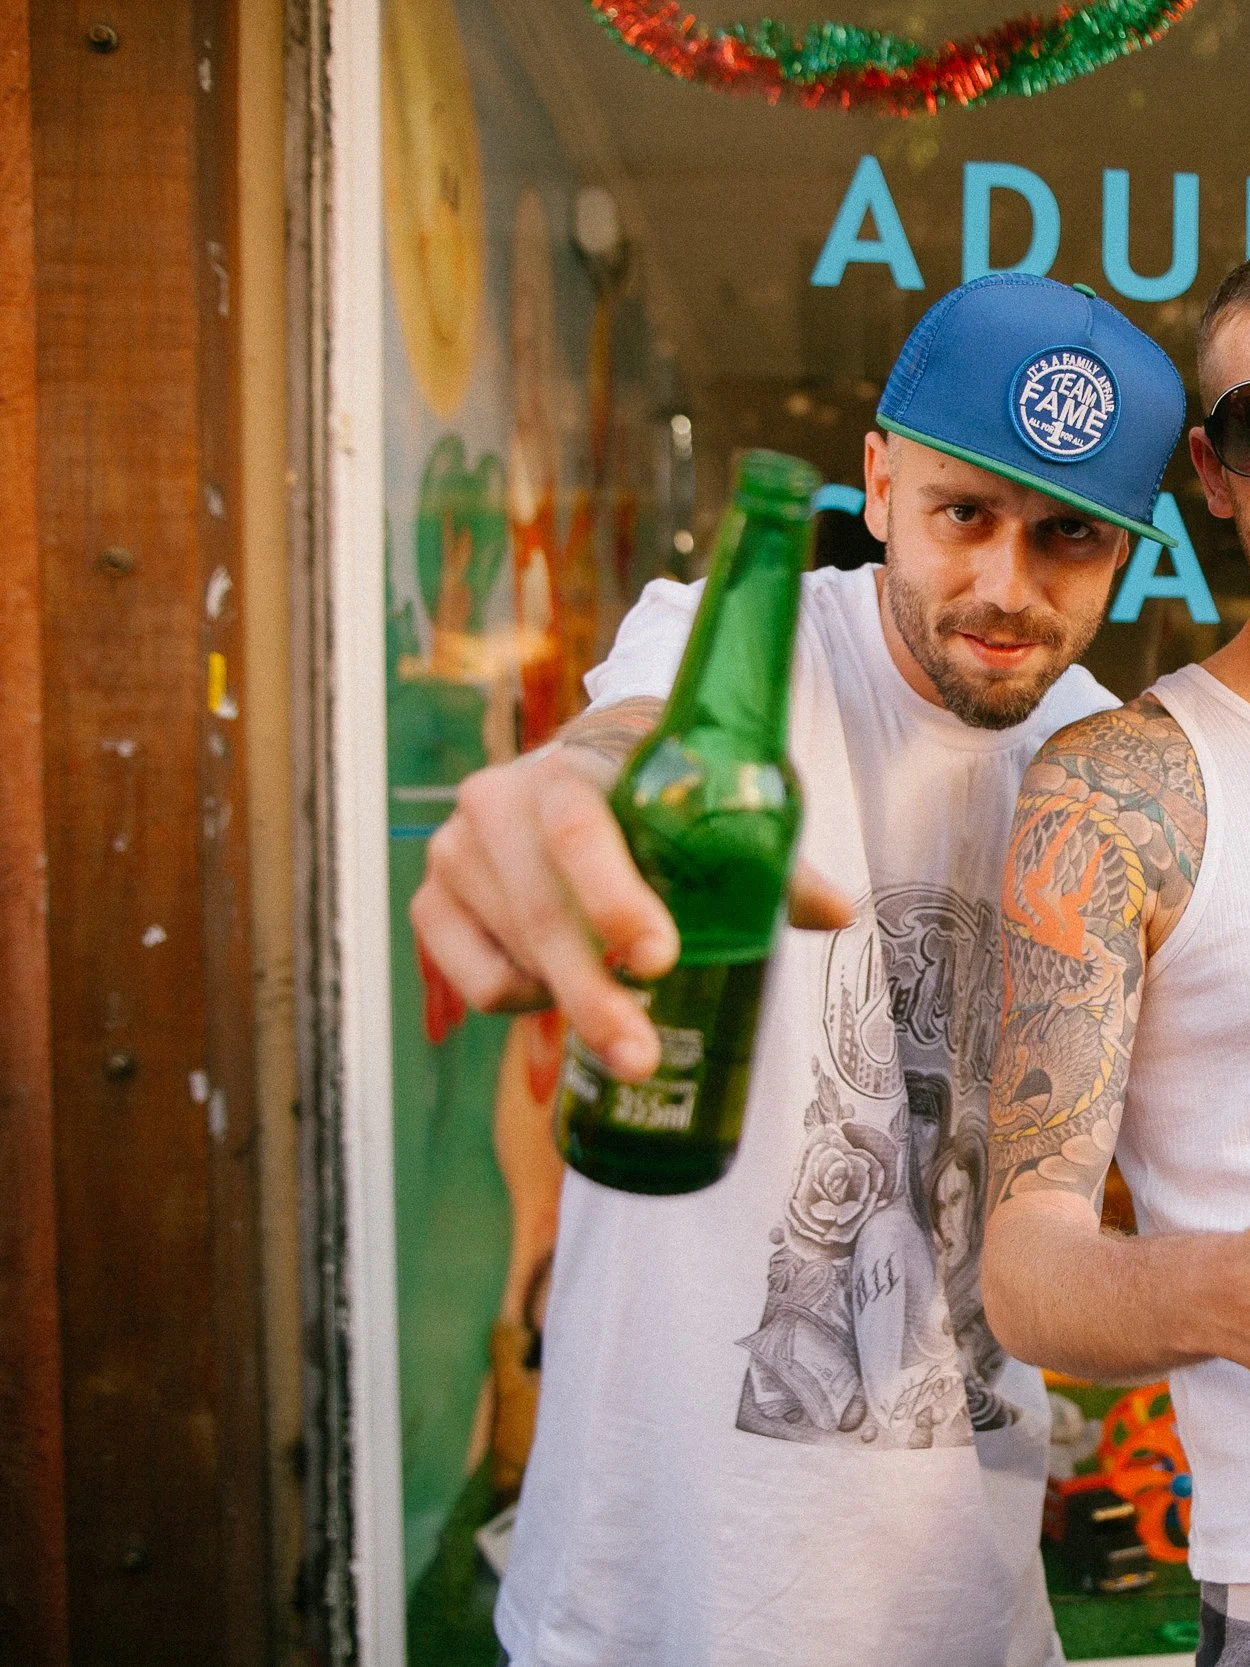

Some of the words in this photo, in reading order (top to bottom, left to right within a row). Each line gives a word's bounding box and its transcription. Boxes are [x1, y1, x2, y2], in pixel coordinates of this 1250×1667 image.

[1027, 359, 1049, 379] IT'S
[1052, 355, 1060, 366] A
[1063, 353, 1100, 375] FAMILY
[1098, 375, 1115, 412] AFFAIR
[1051, 373, 1097, 408] TEAM
[1019, 380, 1108, 439] FAME
[1028, 417, 1041, 428] ALL
[1040, 422, 1055, 434] FOR
[1046, 421, 1062, 446] 1
[1060, 431, 1074, 442] FOR
[1071, 437, 1084, 447] ALL
